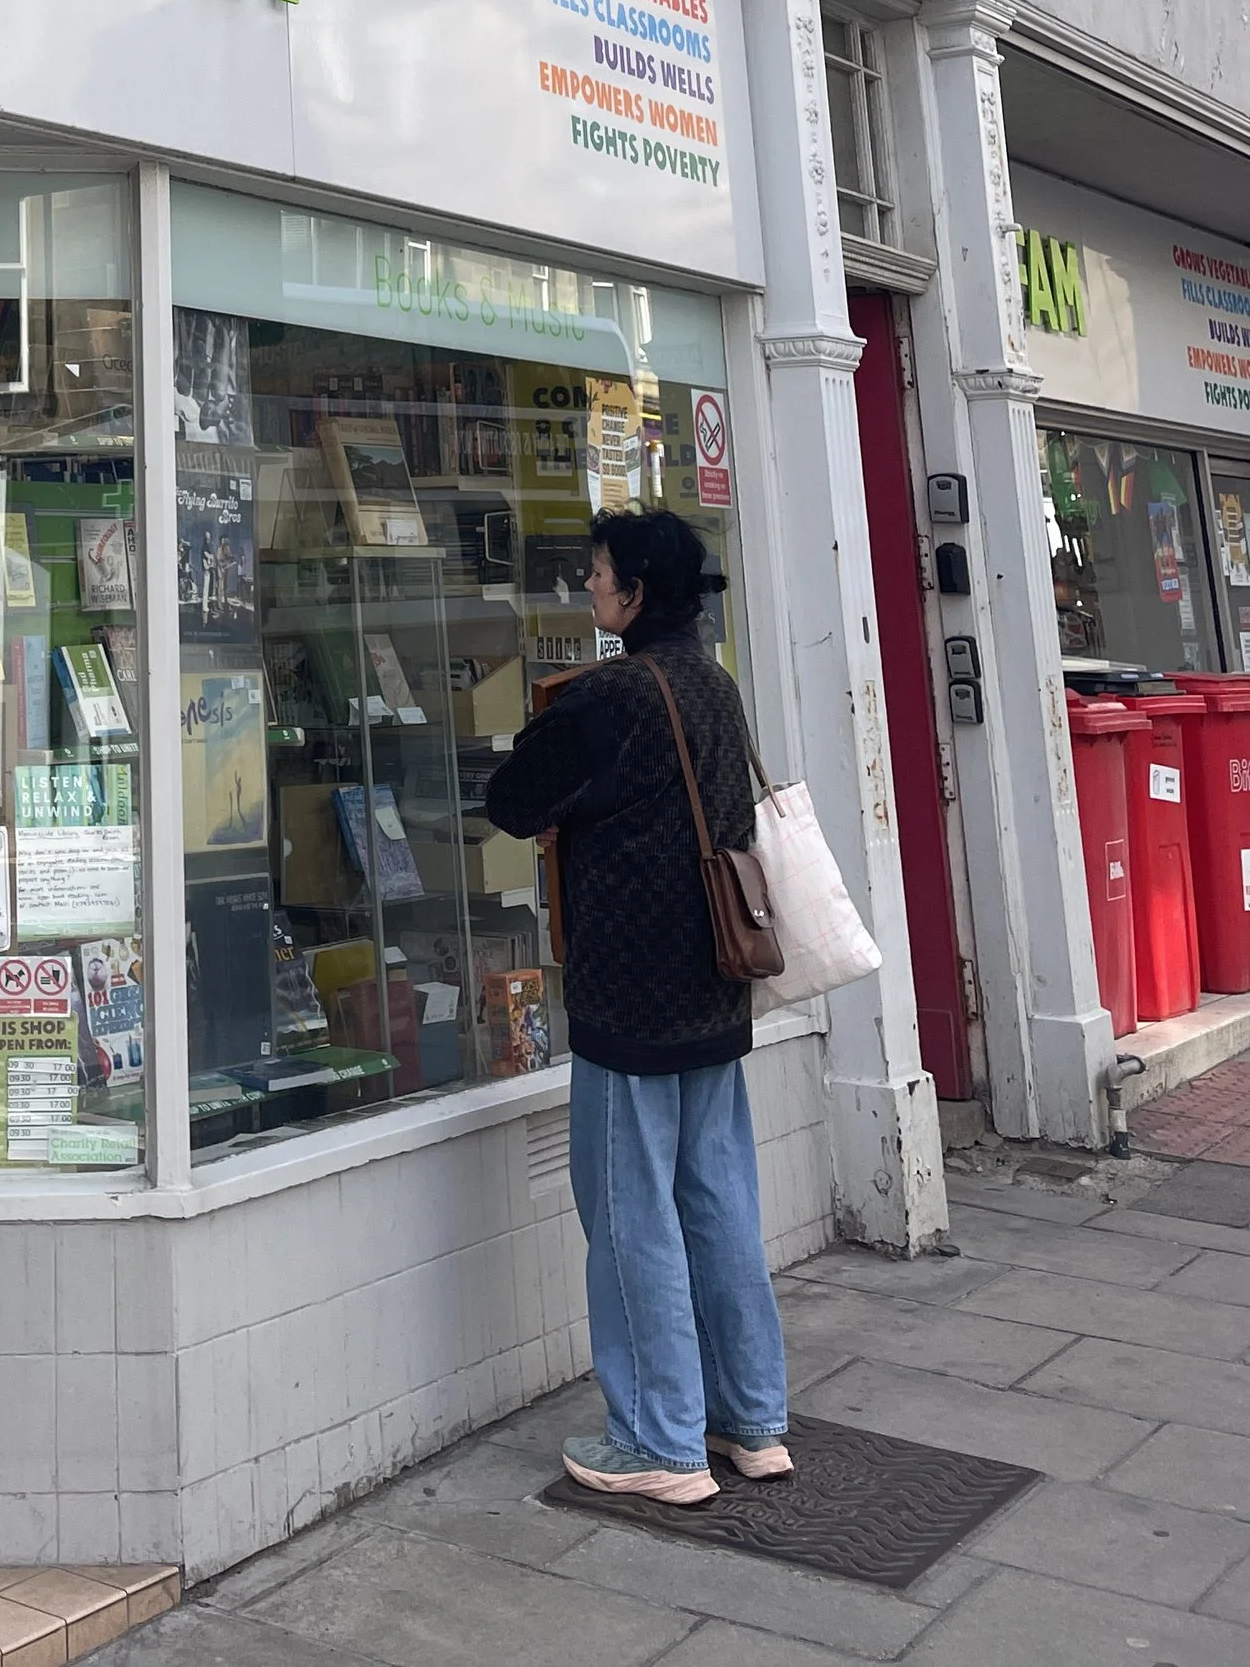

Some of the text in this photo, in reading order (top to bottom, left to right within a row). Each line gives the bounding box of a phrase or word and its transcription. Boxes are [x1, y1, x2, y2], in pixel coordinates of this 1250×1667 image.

[593, 35, 716, 105] BUILDS WELLS
[539, 61, 718, 147] EMPOWERS WOMEN
[570, 114, 721, 187] FIGHTS POVERTY
[1172, 245, 1207, 277] GROWS
[1181, 278, 1205, 306] FILLS
[1208, 319, 1241, 347] BUILDS
[1187, 346, 1237, 378] EMPOWERS
[1204, 381, 1238, 410] FIGHTS
[602, 403, 628, 420] POSITIVE
[602, 418, 625, 433] CHANGE
[602, 433, 621, 447] NEVER
[602, 448, 624, 462] TASTED
[602, 462, 610, 475] SO
[177, 490, 239, 511] Flying Burrito
[218, 509, 242, 524] Bros
[91, 584, 125, 594] RICHARD
[91, 594, 127, 604] WISEMAN
[21, 776, 89, 789] LISTEN,
[21, 791, 96, 803] RELAX &
[21, 805, 92, 818] UNWIND
[88, 989, 109, 1007] 101
[20, 1020, 66, 1035] SHOP
[28, 1037, 72, 1050] FROM:
[51, 1151, 122, 1162] Association
